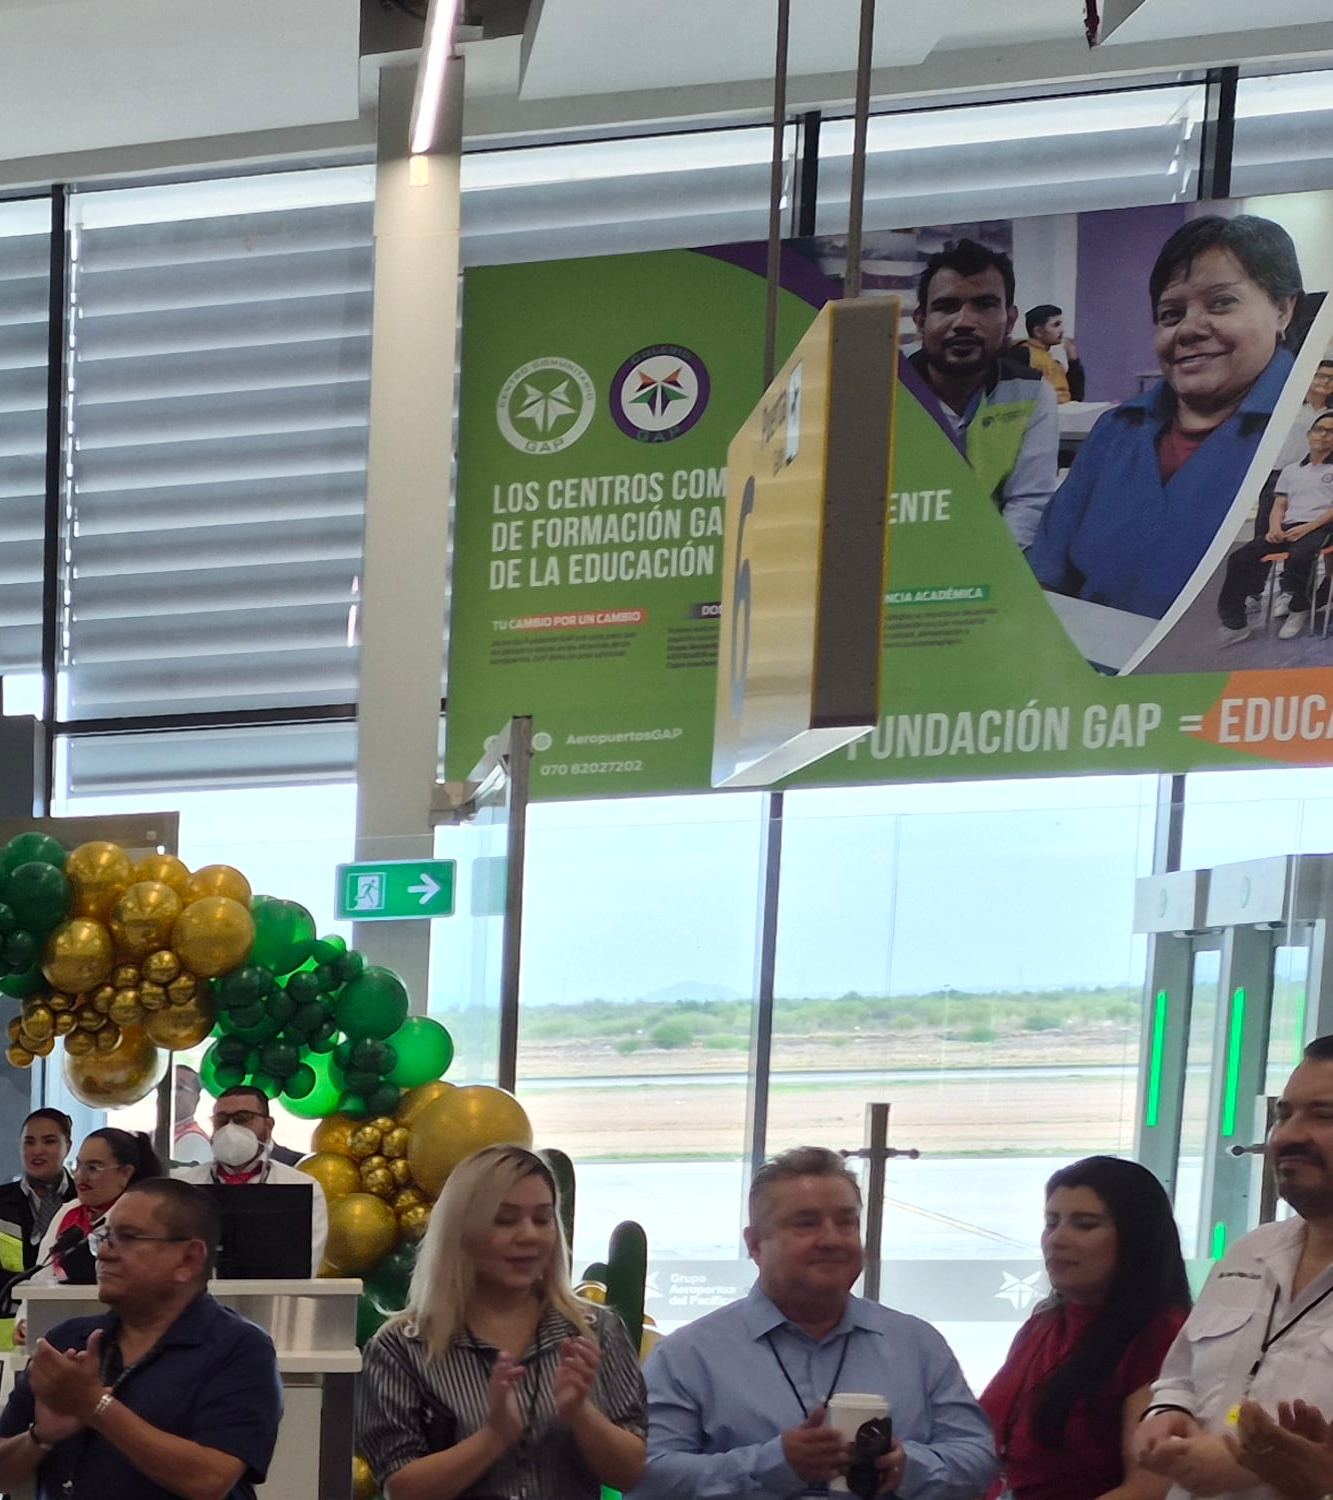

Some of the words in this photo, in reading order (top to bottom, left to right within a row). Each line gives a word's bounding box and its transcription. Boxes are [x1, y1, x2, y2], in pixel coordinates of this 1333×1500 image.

[525, 438, 566, 453] GAP
[493, 481, 540, 514] LOS
[547, 472, 663, 510] CENTROS
[672, 466, 729, 501] COM
[491, 520, 523, 553] DE
[531, 504, 682, 550] FORMACIÓN
[689, 506, 724, 538] GA
[888, 489, 952, 525] ENTE
[490, 558, 522, 591] DE
[529, 556, 560, 588] LA
[568, 540, 715, 585] EDUCACIÓN
[885, 592, 912, 604] NCIA
[492, 620, 507, 631] TU
[509, 616, 552, 630] CAMBIO
[553, 615, 577, 627] POR
[578, 613, 595, 625] UN
[596, 611, 641, 624] CAMBIO
[1082, 702, 1162, 749] GAP
[566, 728, 683, 746] AeropuertosGAP
[540, 763, 567, 776] 070
[670, 1273, 707, 1285] Grupo
